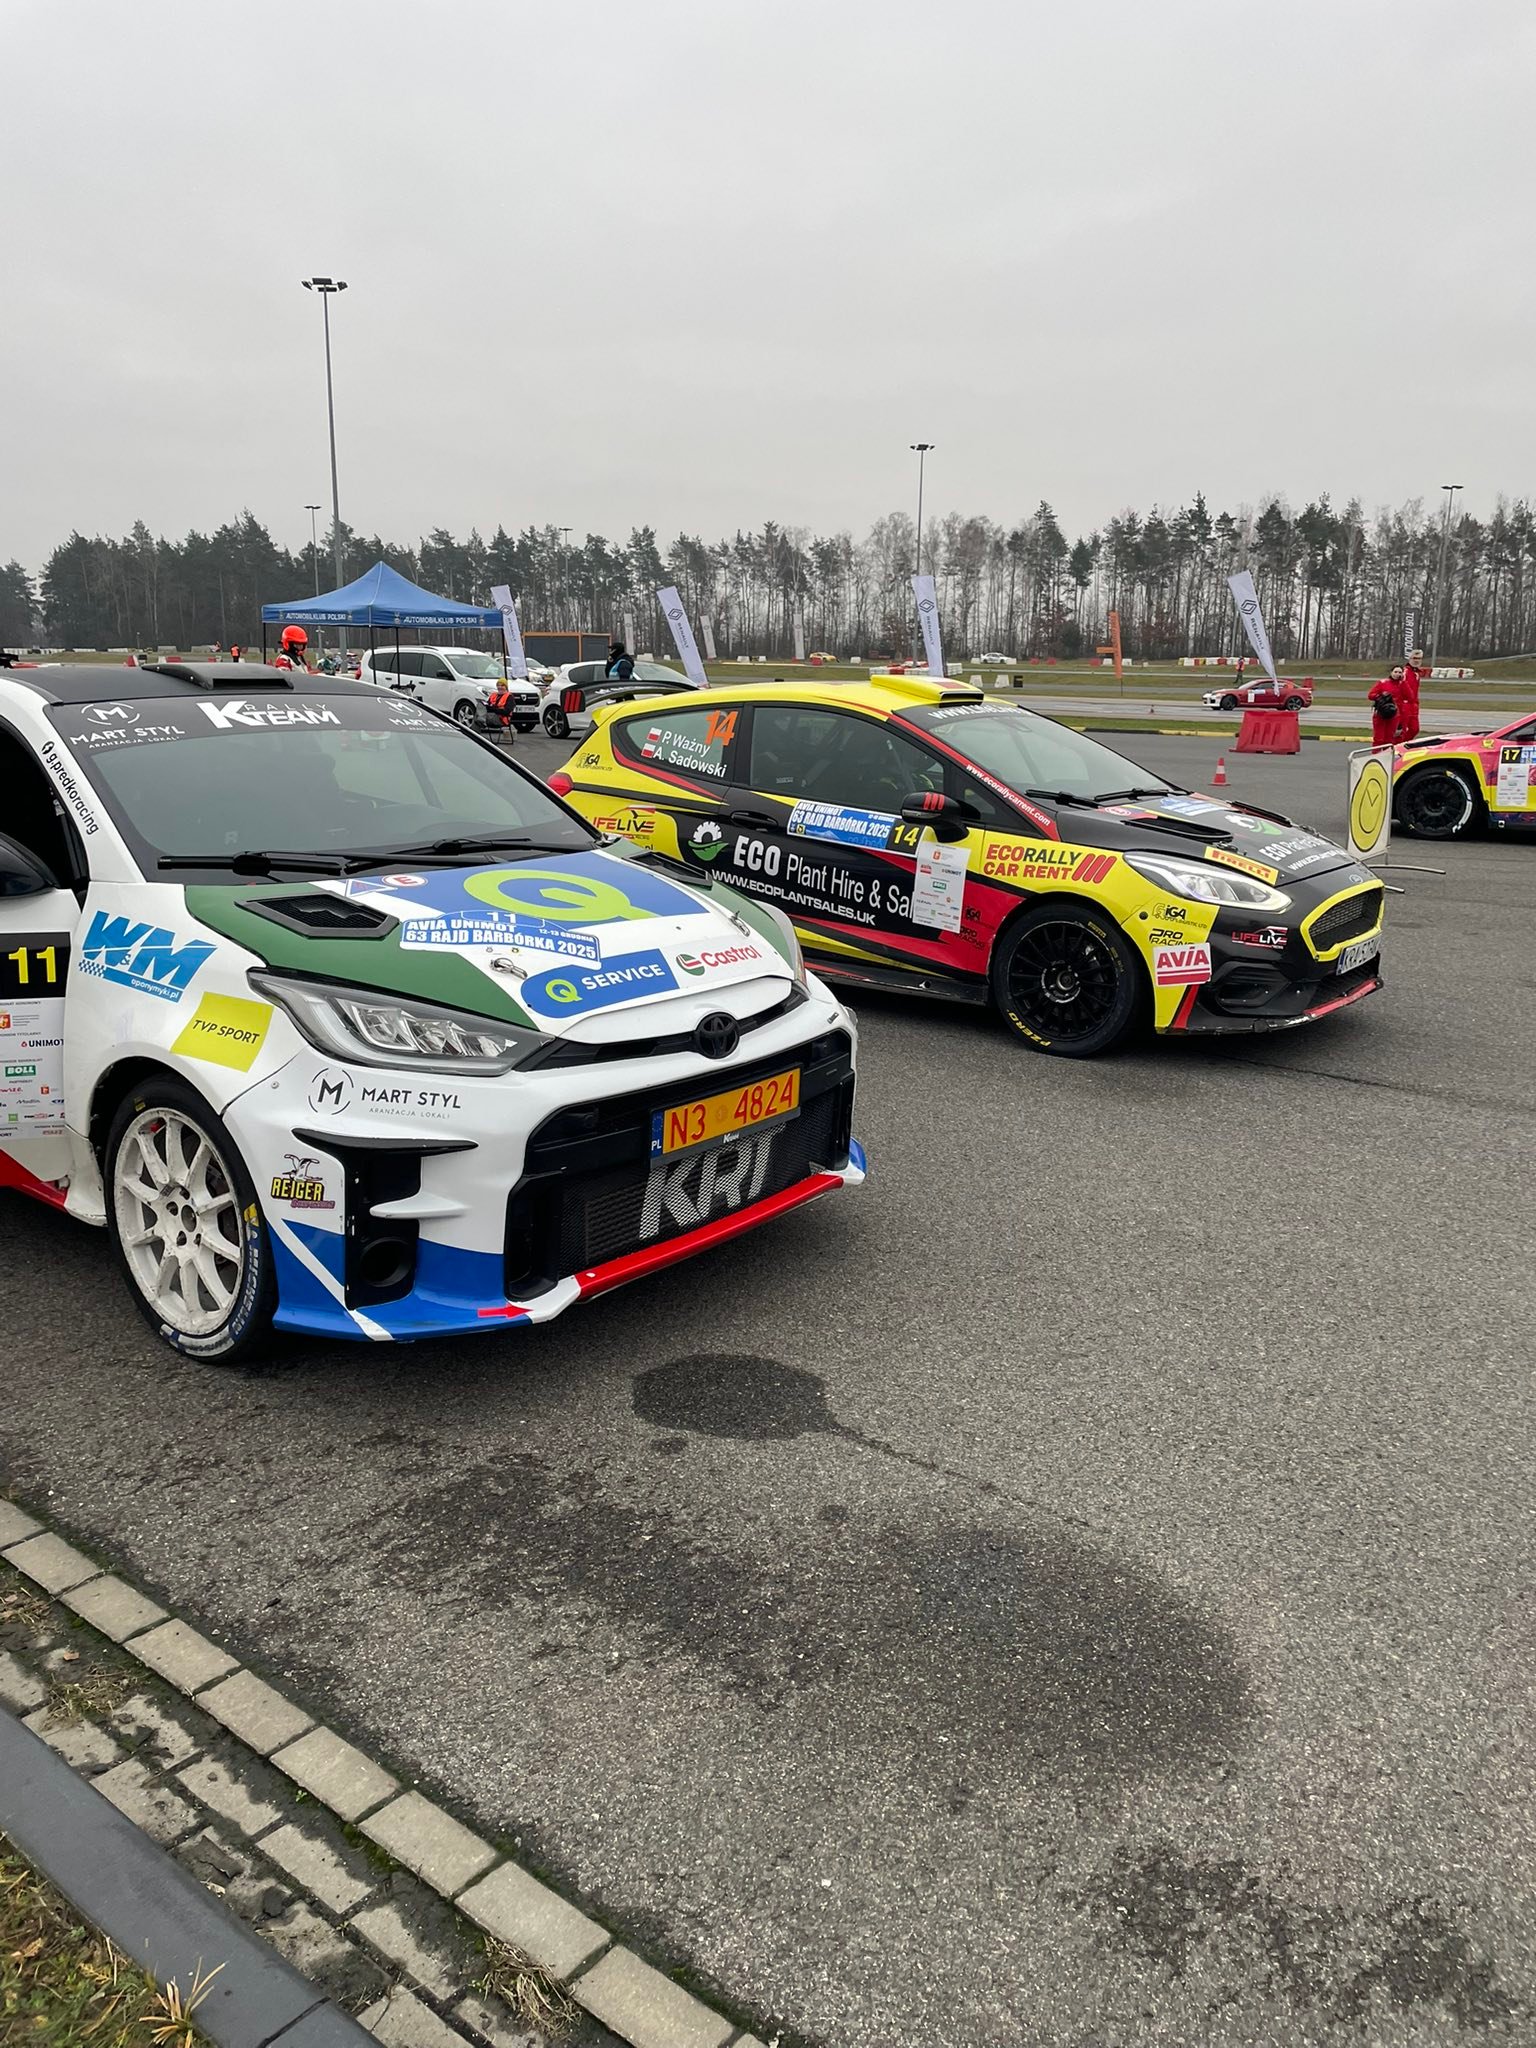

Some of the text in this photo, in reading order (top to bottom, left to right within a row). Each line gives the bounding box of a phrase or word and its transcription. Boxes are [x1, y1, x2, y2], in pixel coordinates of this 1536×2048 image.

[285, 612, 346, 621] AUTOMOBILKLUB POLSKI
[404, 616, 454, 624] AUTOMOBILKLUB
[69, 725, 186, 745] MART STYL
[704, 709, 739, 746] 14
[661, 730, 711, 758] P. Ważny
[1503, 749, 1521, 761] 17
[653, 746, 727, 778] A. Sadowski
[46, 752, 100, 836] g.predkoracing
[966, 764, 1051, 827] www.ecorallycarrent.com
[797, 801, 844, 817] AVIA UNIMOT
[586, 816, 657, 833] IFELIVE
[792, 810, 803, 823] 63
[803, 811, 824, 828] RAJD
[823, 814, 867, 835] BARBÓRKA
[866, 822, 891, 838] 2025
[893, 824, 920, 847] 14
[986, 844, 1082, 866] ECORALLY
[1212, 849, 1271, 879] PIRELLI
[733, 834, 781, 876] ECO
[786, 853, 826, 892] Plant
[831, 866, 863, 903] Hire
[868, 879, 881, 909] &
[983, 861, 1073, 880] CAR RENT
[711, 868, 876, 926] WWW.ECOPLANTSALES.UK
[407, 918, 517, 933] AVIA UNIMOT
[486, 911, 517, 924] 11
[405, 928, 597, 959] 63 RAJD BARBÓRKA 2025
[538, 928, 560, 938] 12-13
[8, 946, 57, 984] 11
[700, 944, 762, 968] Castrol
[131, 977, 180, 999] oponymyki.pl
[581, 962, 665, 991] SERVICE
[192, 1019, 260, 1045] TVP SPORT
[7, 1066, 35, 1075] BOLL
[361, 1087, 462, 1109] MART STYL
[670, 1073, 794, 1149] N3 4824
[651, 1139, 662, 1152] PL
[271, 1177, 323, 1201] REIGER
